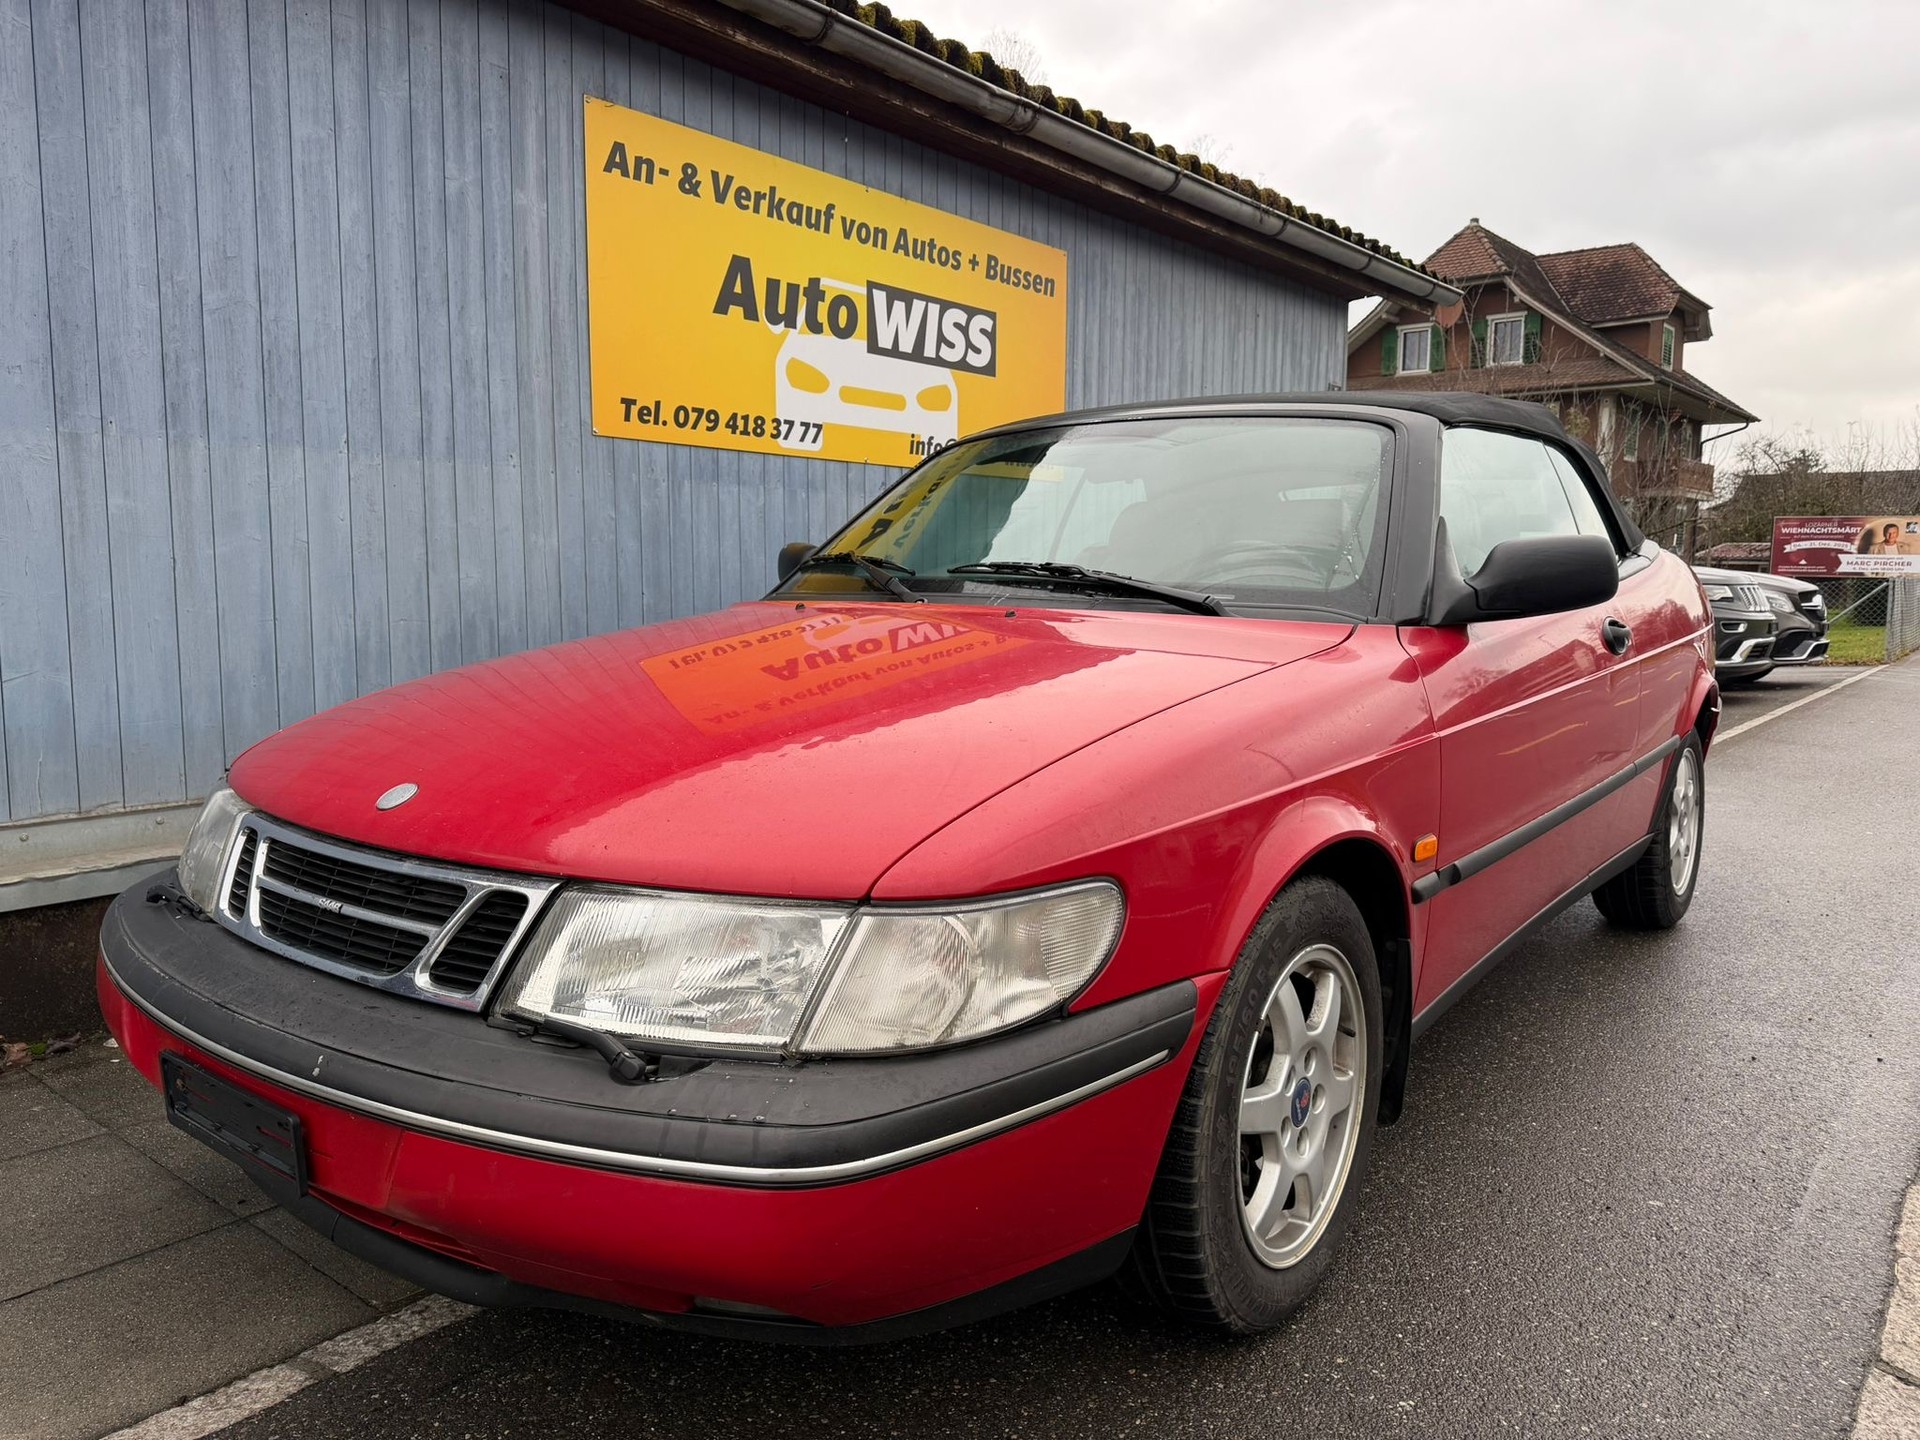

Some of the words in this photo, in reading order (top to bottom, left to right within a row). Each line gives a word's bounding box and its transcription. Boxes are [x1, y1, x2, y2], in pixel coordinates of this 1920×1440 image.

[602, 141, 670, 185] An-
[678, 162, 702, 198] &
[710, 169, 836, 234] Verkauf
[840, 216, 888, 251] von
[892, 227, 962, 271] Autos
[968, 254, 980, 272] +
[985, 254, 1055, 297] Bussen
[712, 254, 859, 340] Auto
[872, 288, 994, 368] WISS
[620, 397, 668, 427] Tel.
[673, 405, 720, 432] 079
[724, 412, 766, 438] 418
[770, 417, 795, 441] 37
[799, 421, 823, 444] 77
